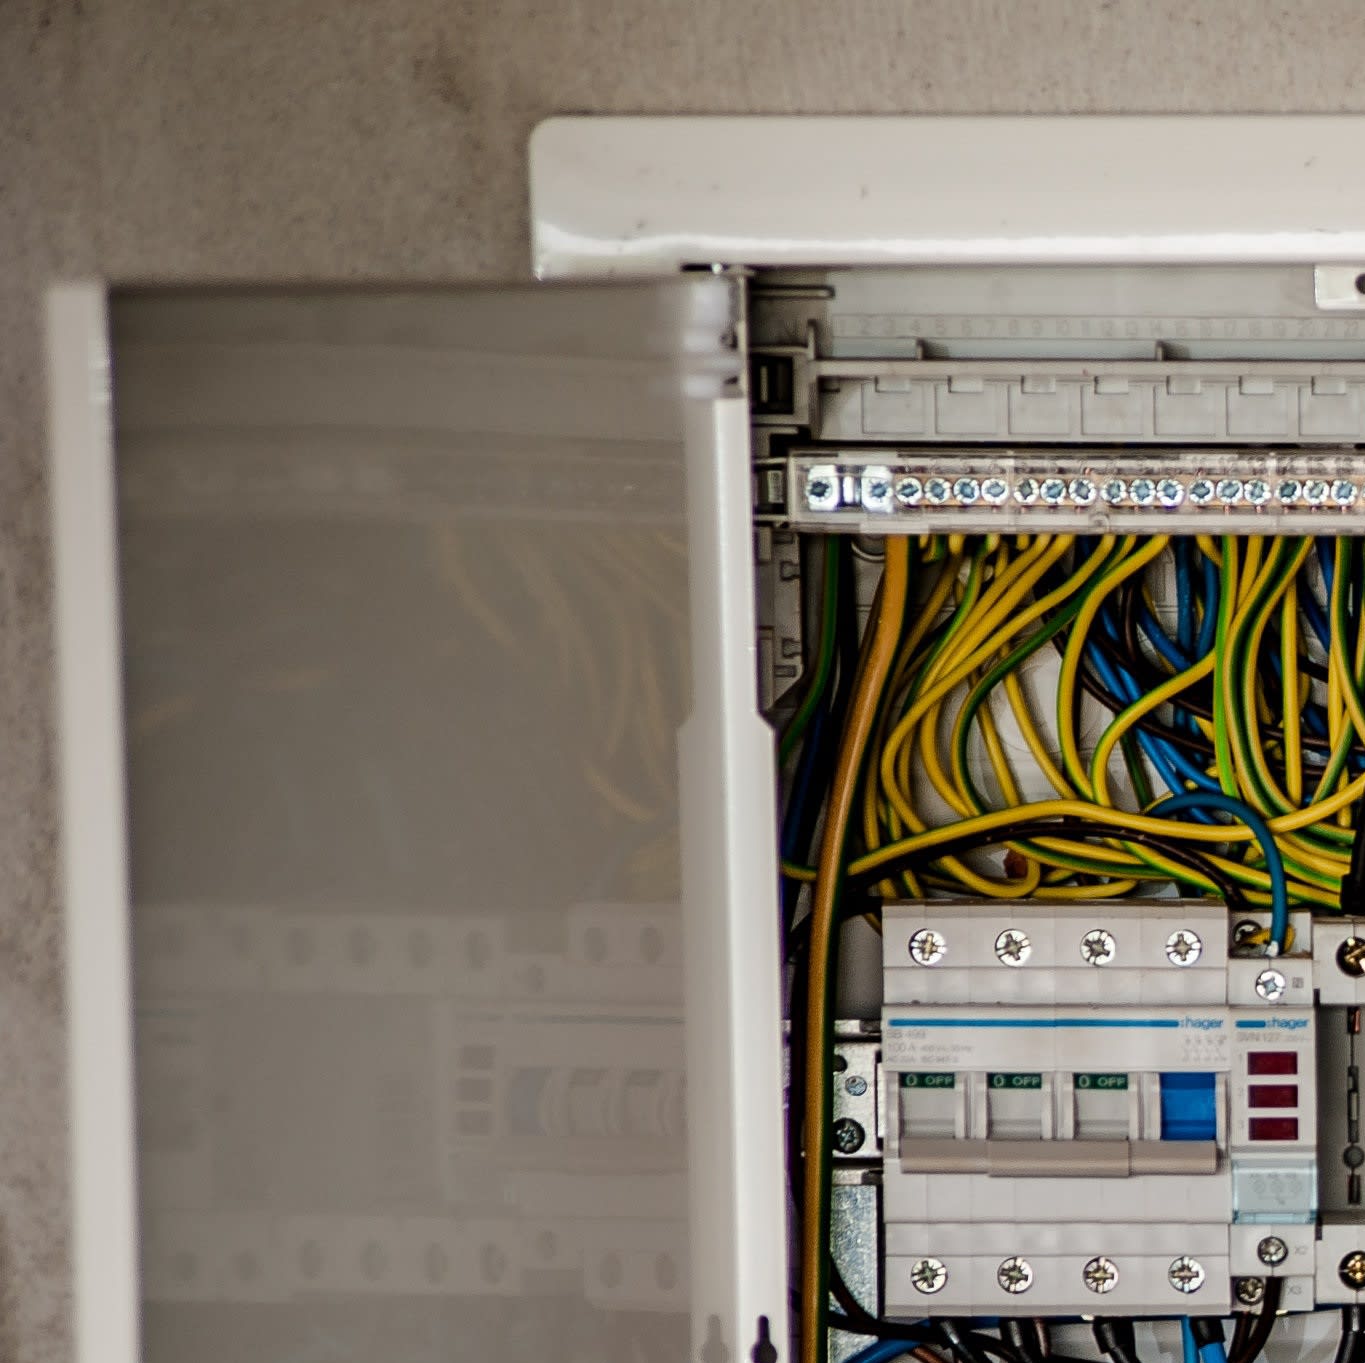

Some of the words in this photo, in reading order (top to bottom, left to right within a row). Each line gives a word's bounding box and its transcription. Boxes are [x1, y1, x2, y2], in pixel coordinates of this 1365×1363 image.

[925, 1075, 953, 1085] OFF
[1012, 1076, 1041, 1086] OFF
[1097, 1076, 1126, 1087] OFF
